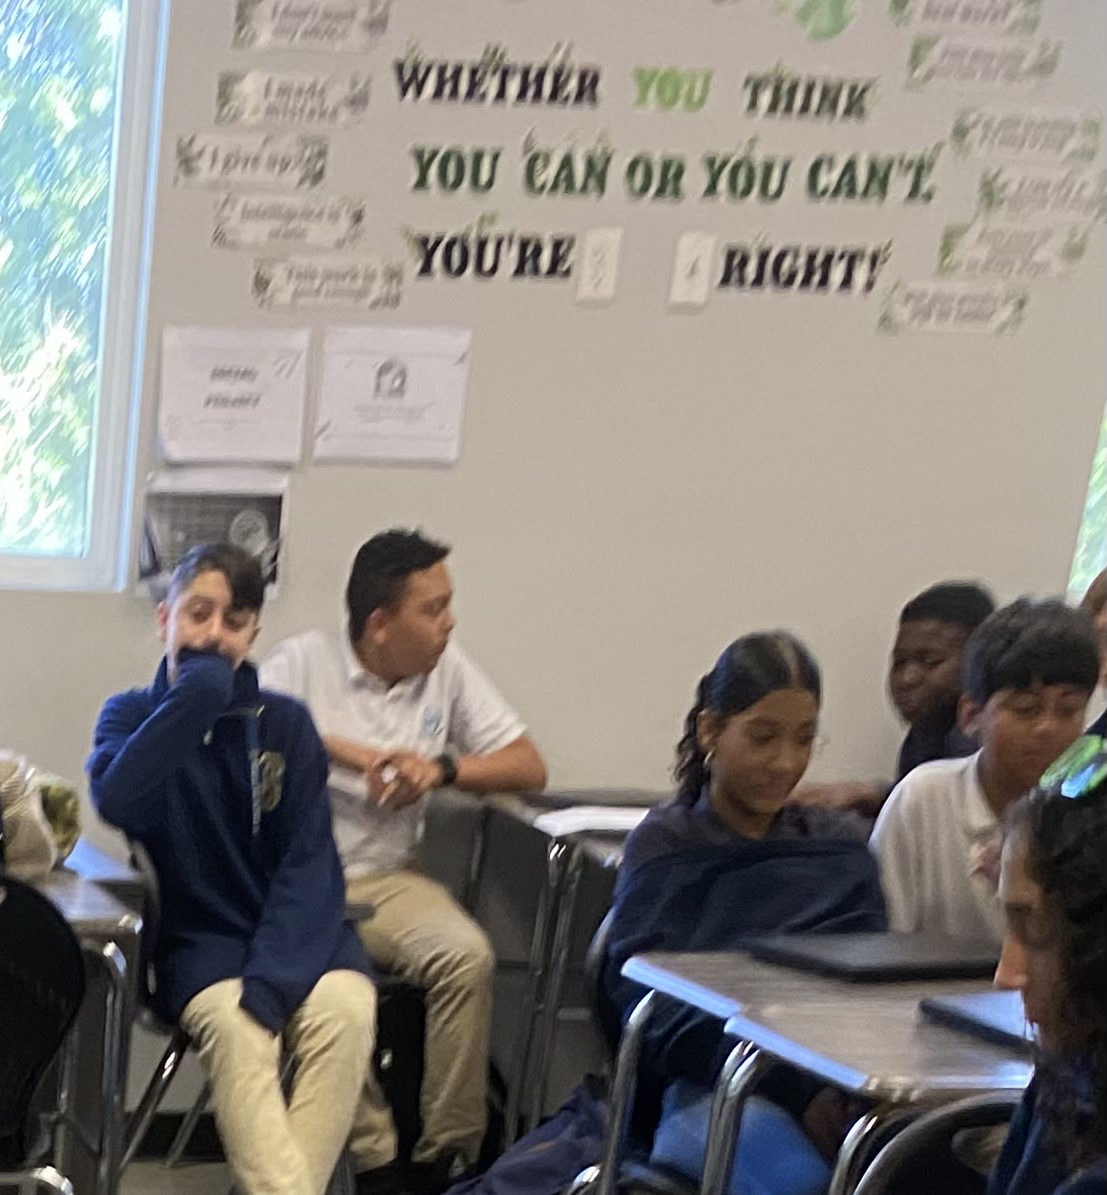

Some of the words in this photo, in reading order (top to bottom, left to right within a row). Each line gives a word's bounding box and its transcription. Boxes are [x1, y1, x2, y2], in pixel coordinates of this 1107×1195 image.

[393, 60, 600, 107] WHETHER
[632, 67, 712, 111] YOU
[742, 74, 878, 119] THINK
[411, 146, 502, 192] YOU
[524, 149, 612, 197] CAN
[625, 153, 685, 200] OR
[701, 155, 791, 201] YOU
[417, 232, 576, 279] YOU'RE
[718, 244, 881, 292] RIGHT!
